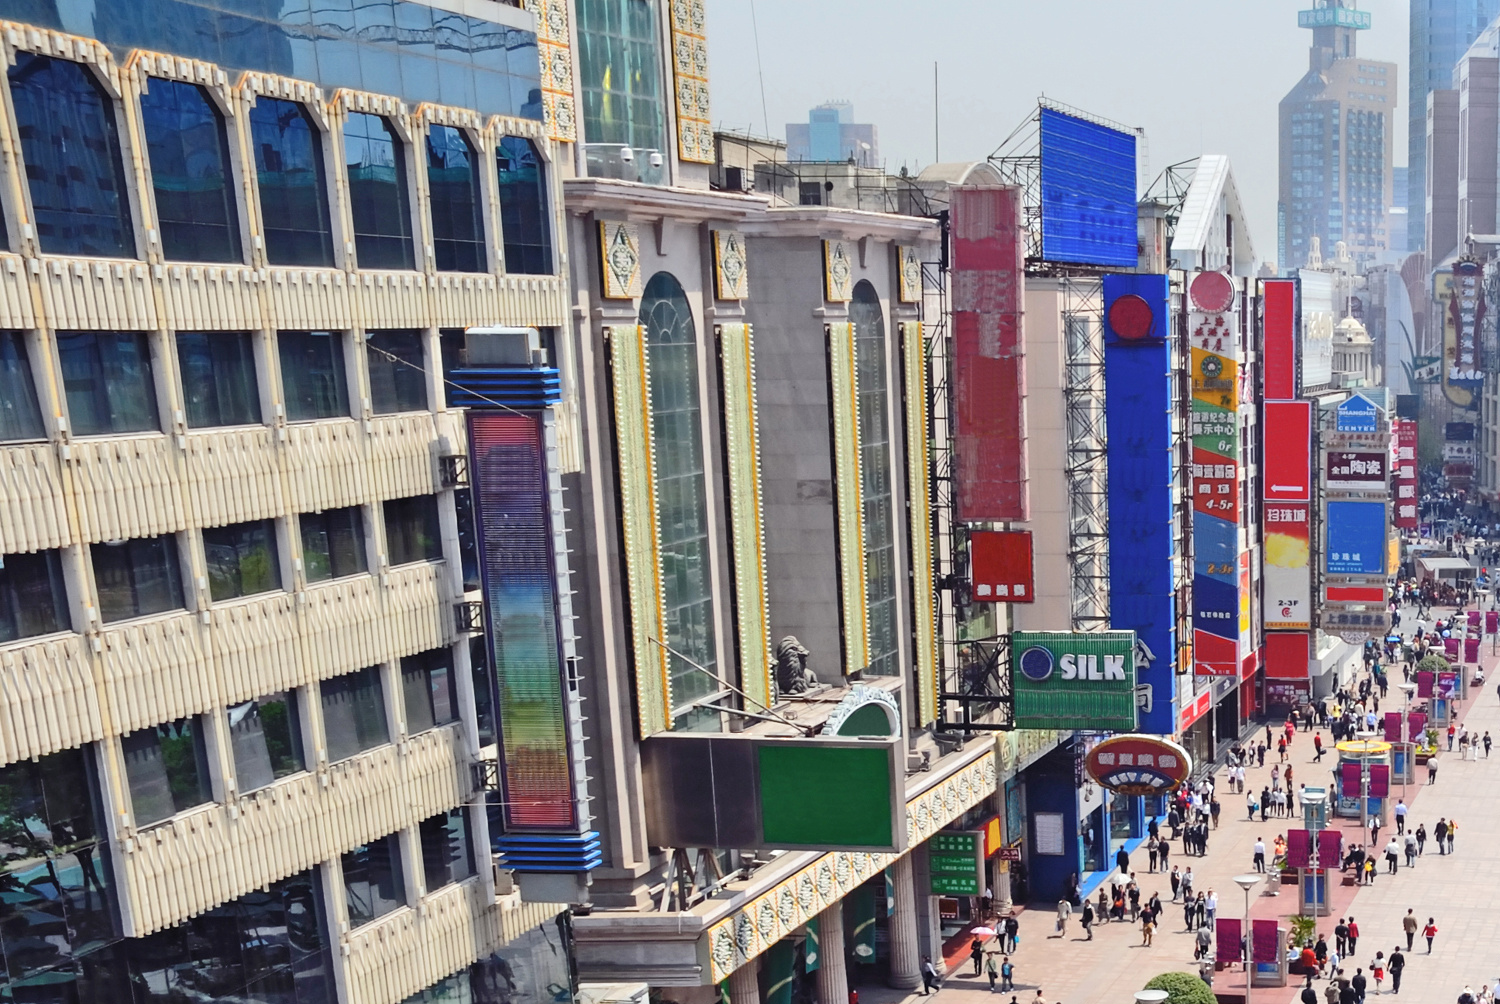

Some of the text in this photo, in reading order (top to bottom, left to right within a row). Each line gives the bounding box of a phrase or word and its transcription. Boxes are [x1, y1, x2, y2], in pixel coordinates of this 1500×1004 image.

[1200, 315, 1225, 327] 上海
[1193, 423, 1235, 436] 展示中心
[1218, 440, 1232, 451] 6F
[1205, 499, 1234, 510] 4-5F
[1267, 508, 1306, 522] 珍珠城
[1207, 563, 1234, 575] 2-3F
[1278, 599, 1299, 607] 2-3F
[1060, 653, 1126, 680] SILK
